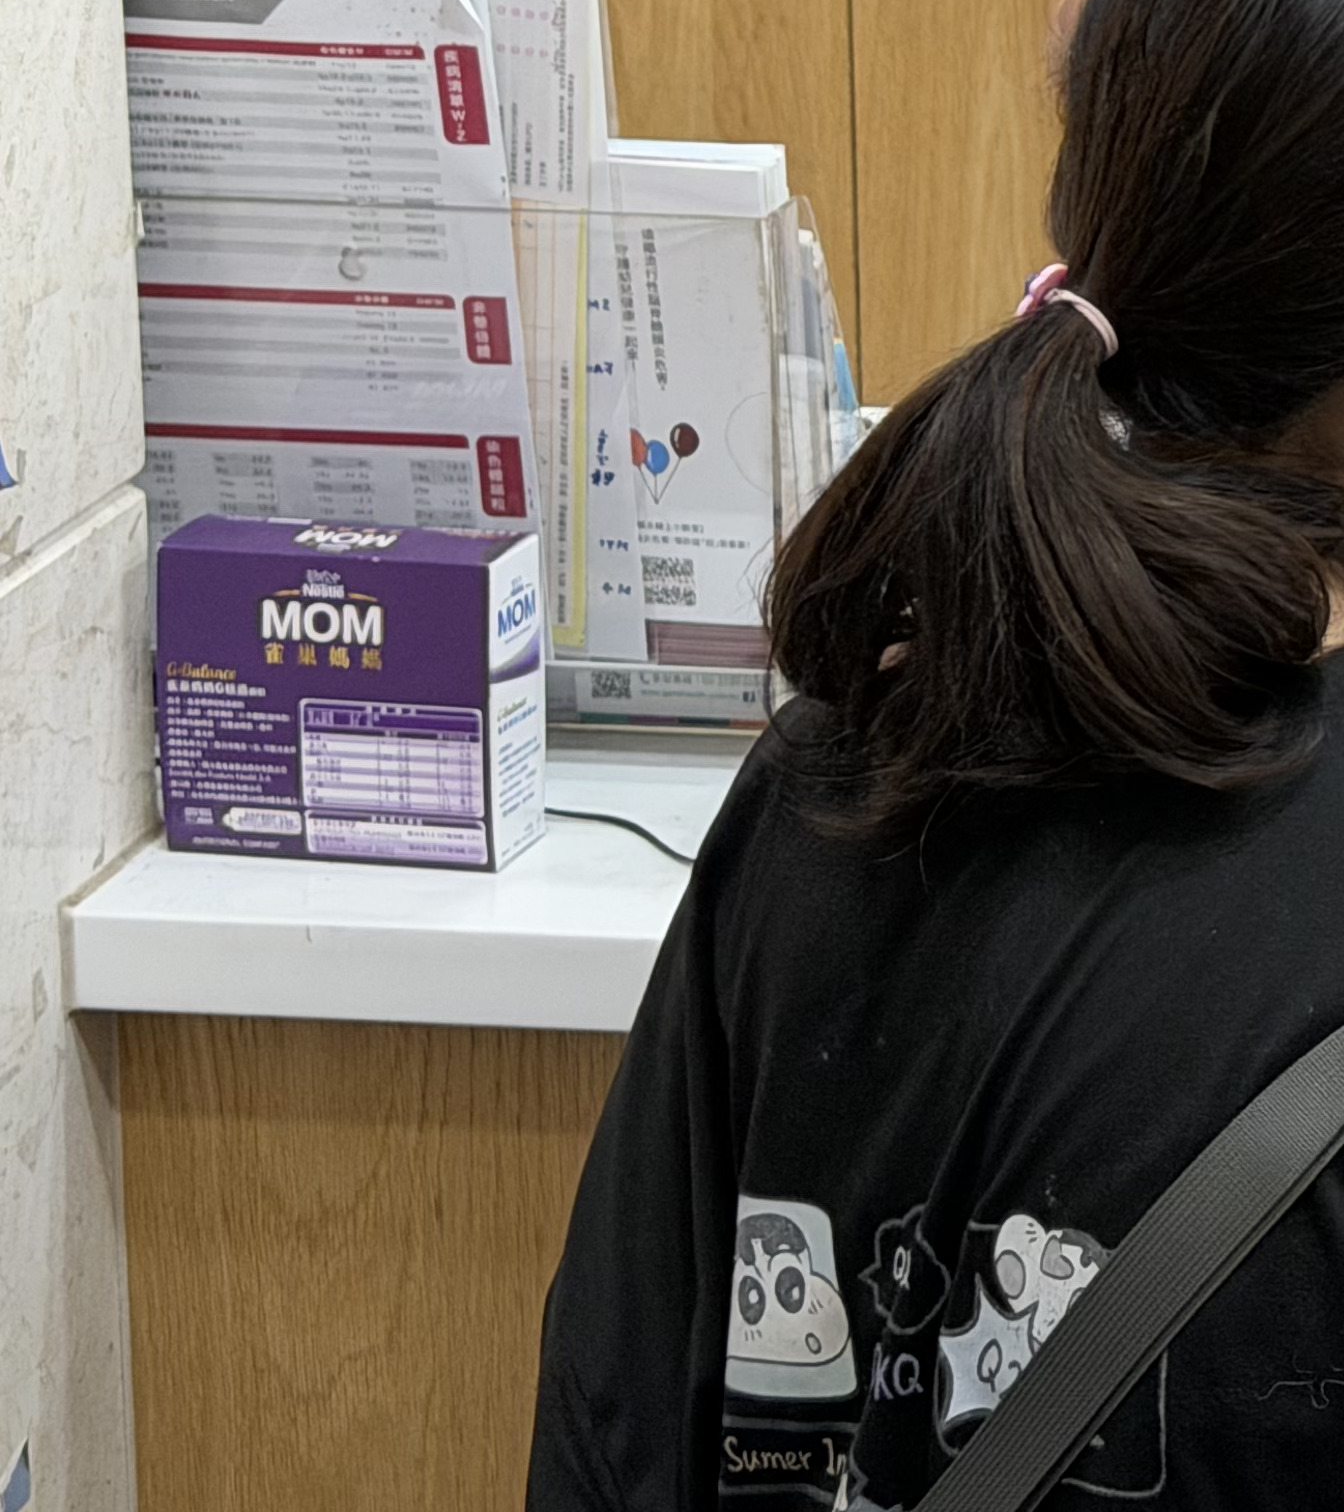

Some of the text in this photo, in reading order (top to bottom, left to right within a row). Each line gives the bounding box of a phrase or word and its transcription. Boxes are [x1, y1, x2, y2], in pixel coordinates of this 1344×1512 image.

[261, 599, 382, 646] MOM
[497, 589, 536, 638] MOM
[871, 1341, 924, 1401] KQ
[723, 1434, 813, 1473] Sumer
